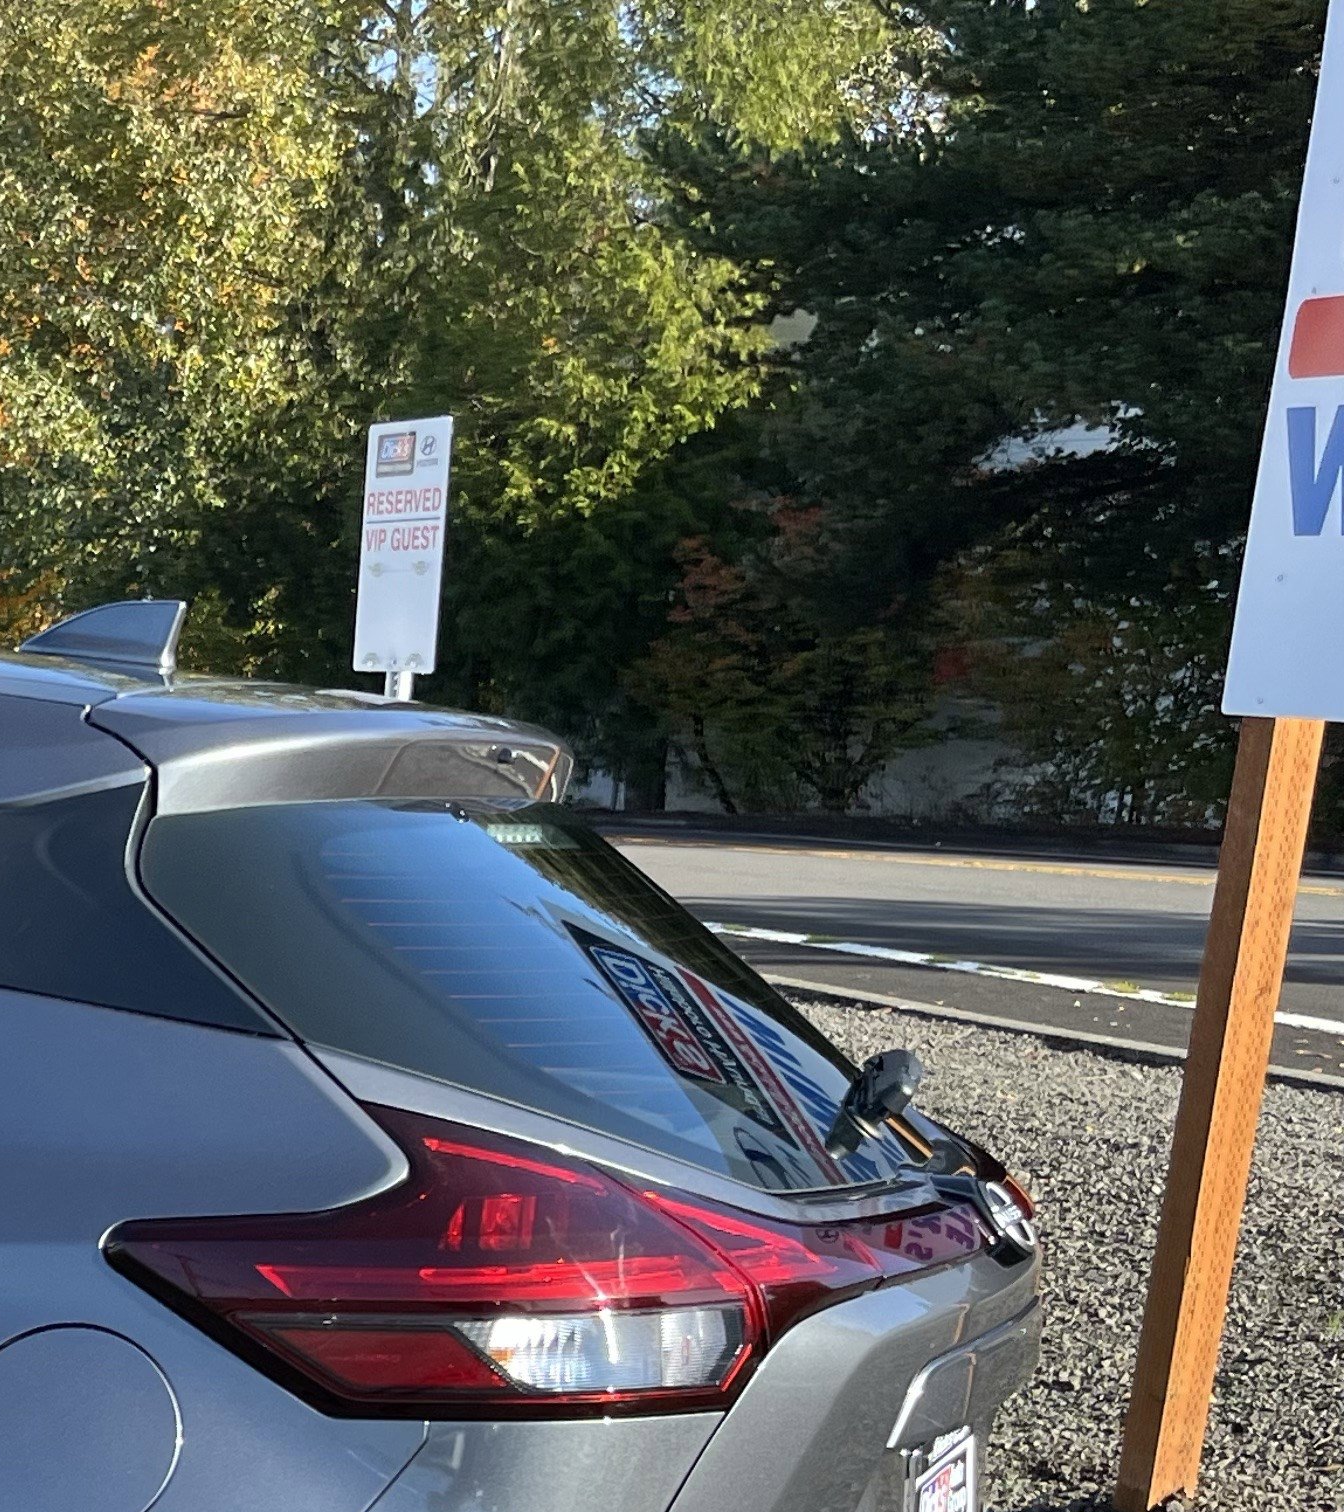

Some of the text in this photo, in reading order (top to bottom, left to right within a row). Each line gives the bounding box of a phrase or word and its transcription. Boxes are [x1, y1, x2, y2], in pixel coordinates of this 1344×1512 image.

[367, 487, 442, 516] RESERVED
[366, 525, 440, 552] VIP GUEST
